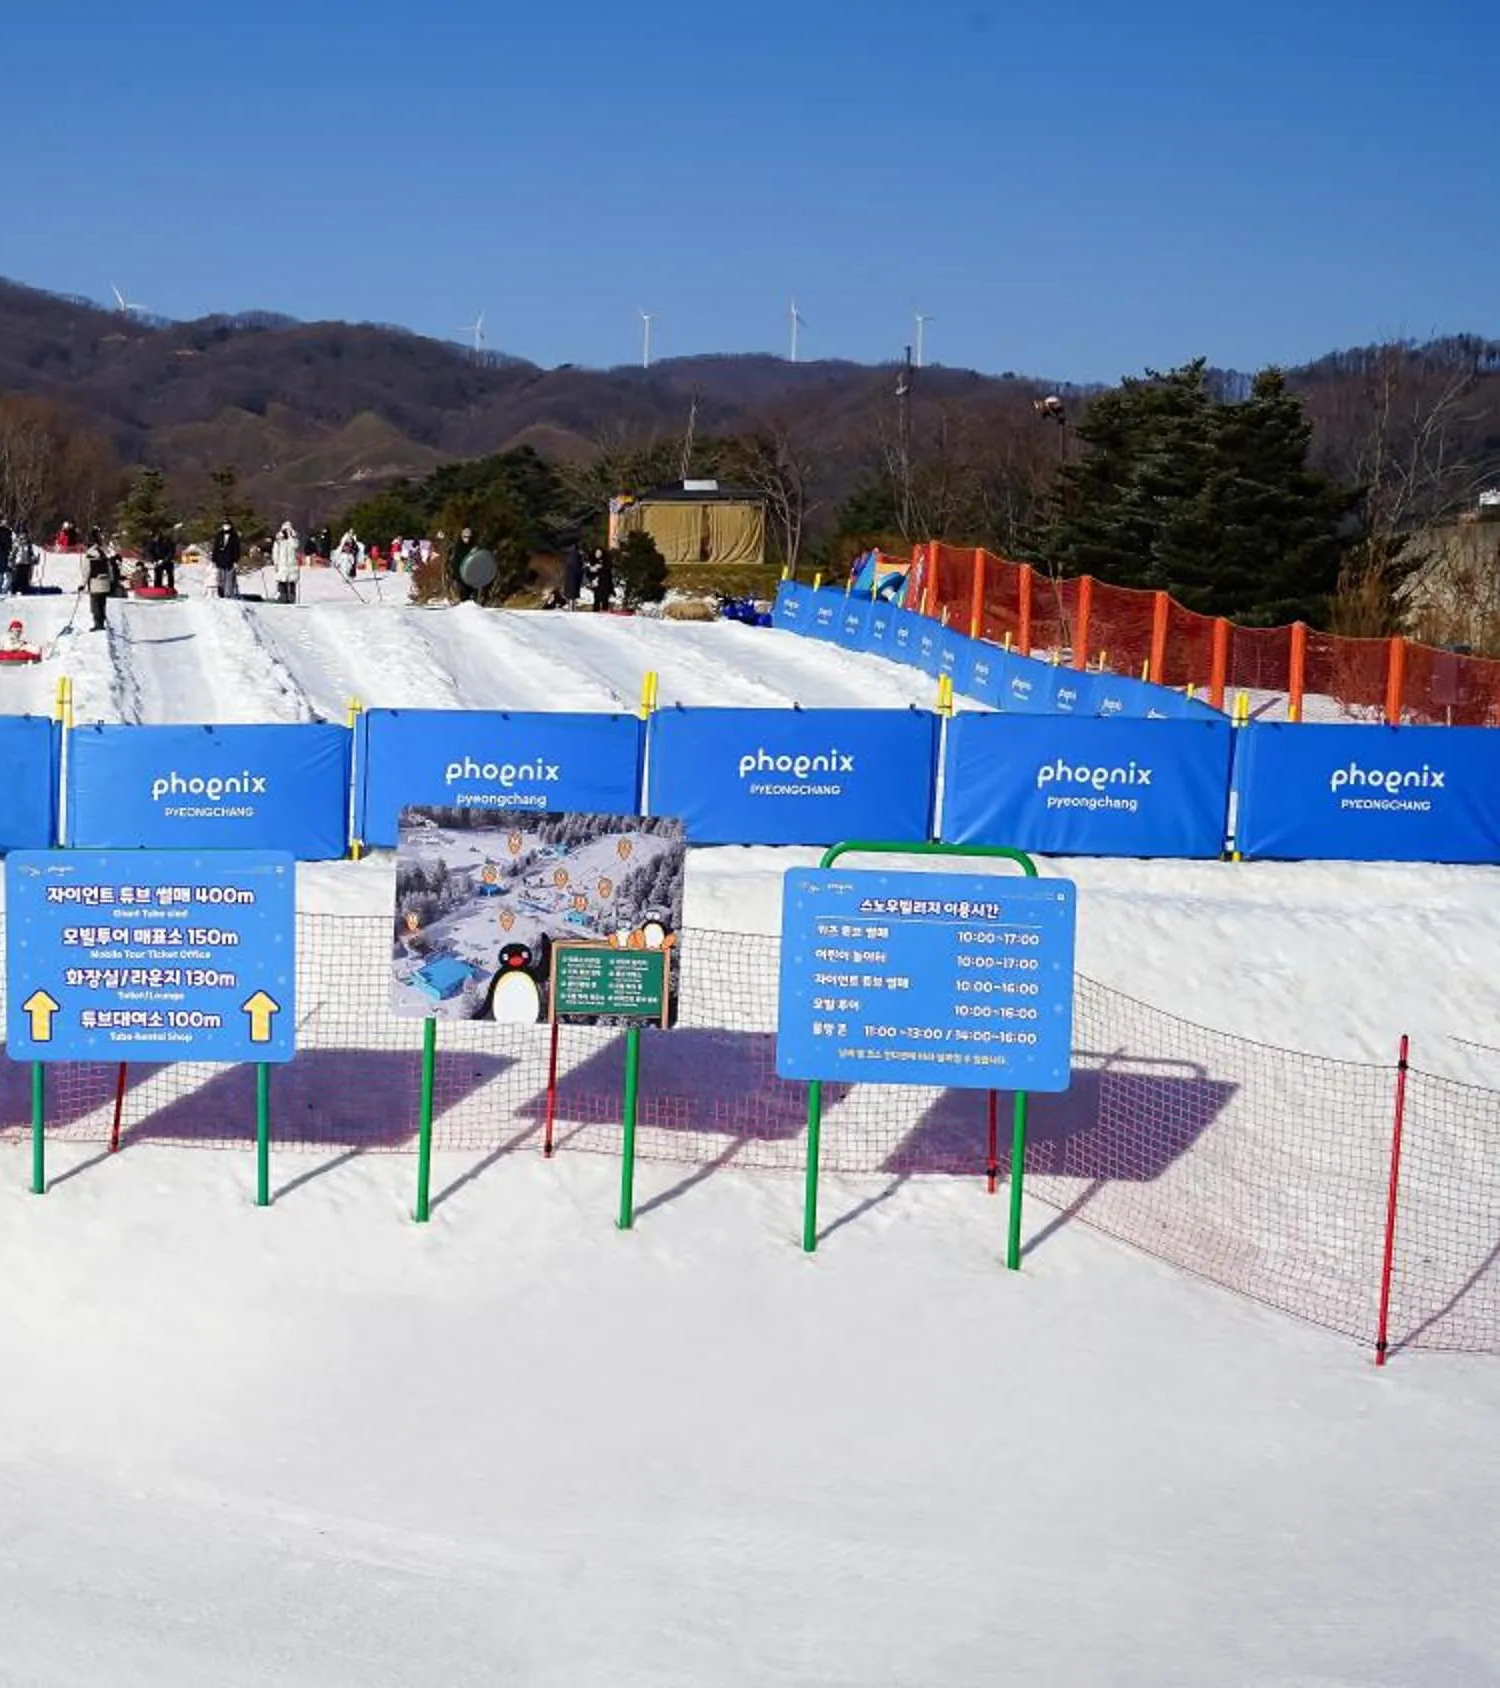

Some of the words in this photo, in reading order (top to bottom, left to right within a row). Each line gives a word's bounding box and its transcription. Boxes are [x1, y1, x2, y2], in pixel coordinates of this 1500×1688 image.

[445, 756, 560, 787] phoenix
[739, 748, 854, 779] phoenix
[1037, 759, 1152, 791] phoenix
[152, 770, 267, 801] phoenix
[1330, 762, 1445, 793] phoenix
[47, 886, 115, 905] 자이언트
[119, 887, 151, 904] 튜브
[156, 886, 192, 906] 썰매
[195, 887, 255, 904] 400m
[859, 898, 944, 916] 스노우빌리지
[944, 901, 1000, 919] 이용시간
[63, 928, 129, 947] 모빌투어
[134, 928, 183, 946] 매표소
[187, 929, 239, 946] 150m
[185, 969, 236, 987] 130m
[80, 1011, 164, 1029] 튜브대여소
[167, 1011, 222, 1028] 100m
